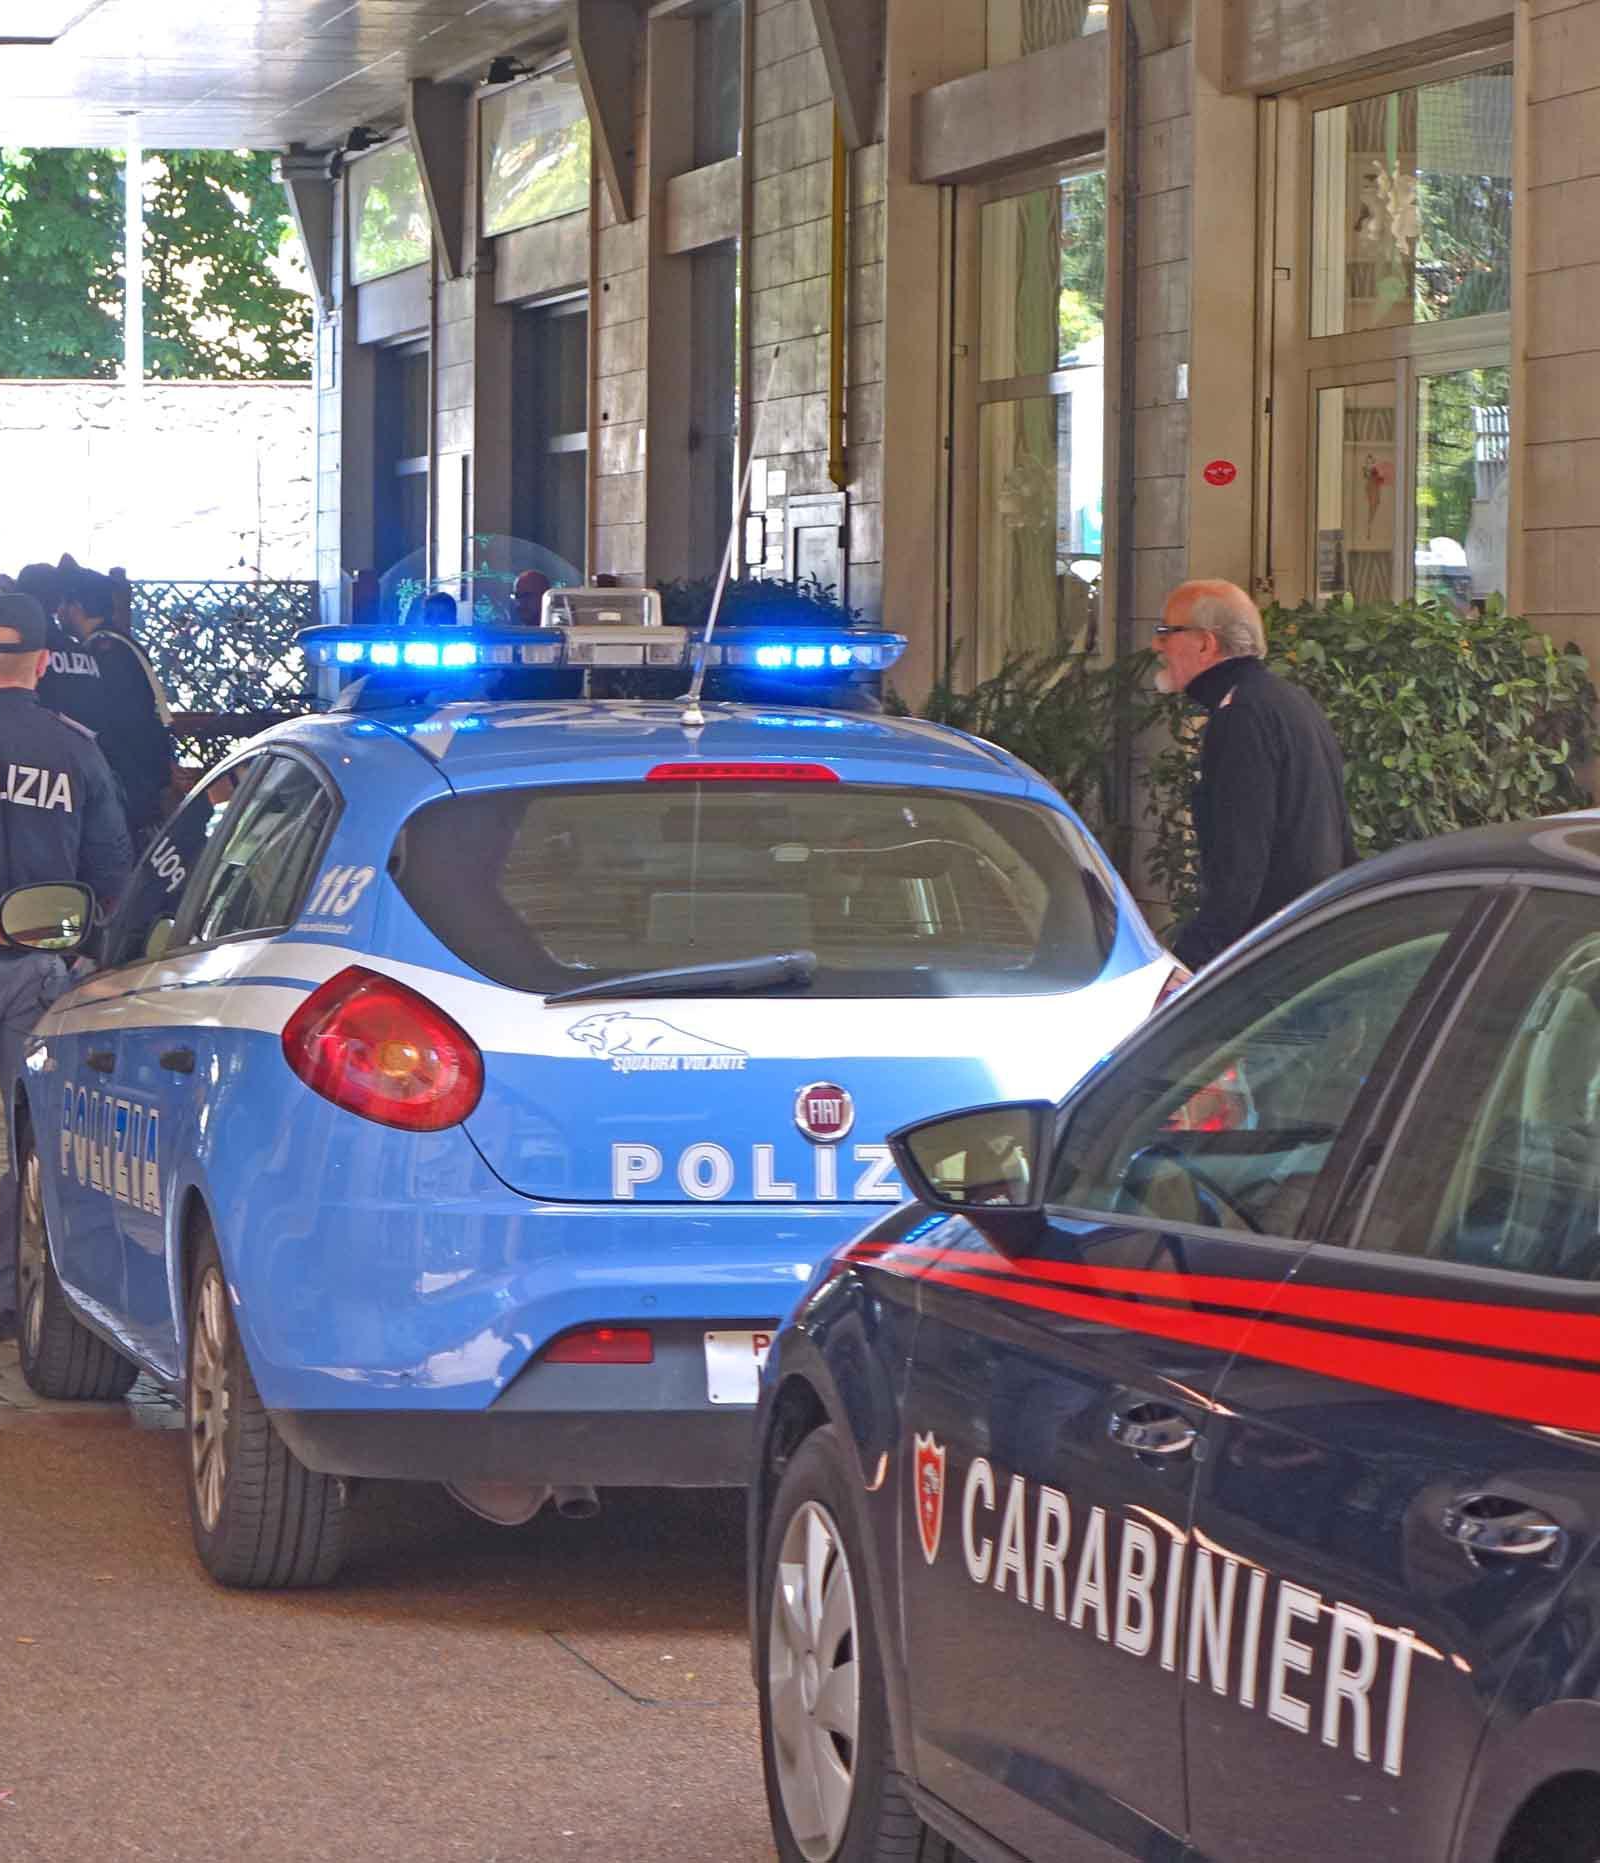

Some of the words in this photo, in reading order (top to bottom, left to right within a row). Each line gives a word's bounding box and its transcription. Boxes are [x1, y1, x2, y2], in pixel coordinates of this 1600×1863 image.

[48, 651, 100, 679] OLIZIA
[306, 865, 376, 917] 113
[611, 1056, 678, 1074] SQUADRA
[681, 1055, 747, 1071] VOLANTE
[807, 1099, 842, 1126] FIAT
[61, 1081, 162, 1217] POLIZIA
[961, 1457, 1416, 1777] CARABINIERI
